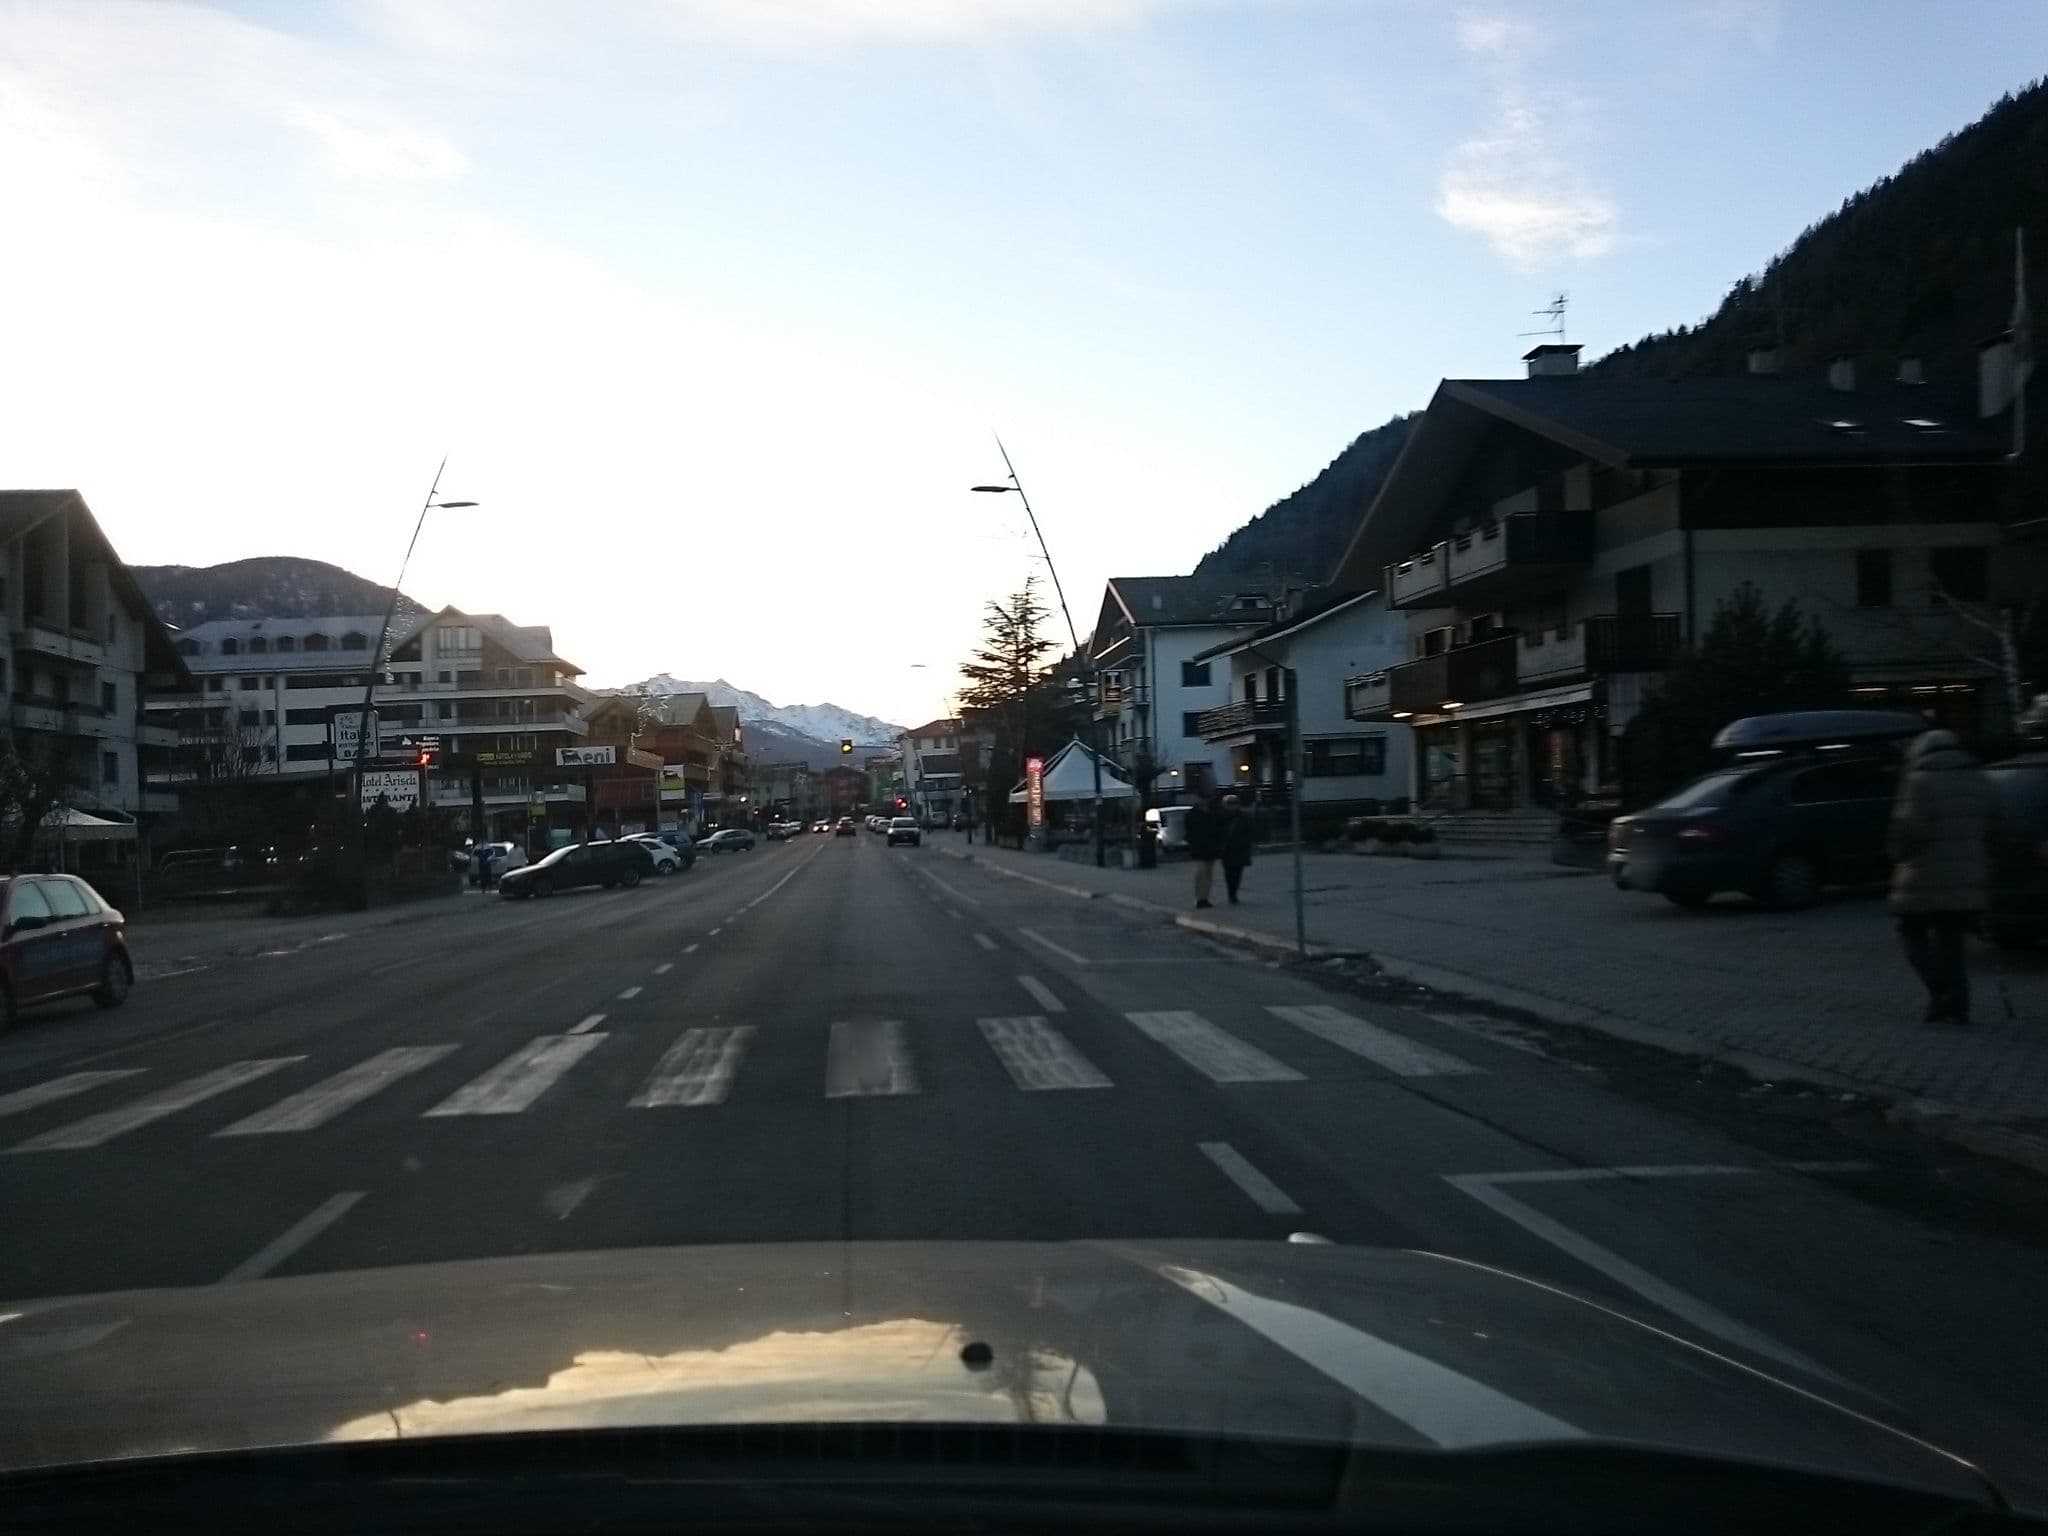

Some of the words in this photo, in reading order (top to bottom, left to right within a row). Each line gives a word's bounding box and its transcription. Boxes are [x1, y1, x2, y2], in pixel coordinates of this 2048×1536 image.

[341, 730, 371, 740] Itala
[583, 747, 610, 764] eni
[362, 793, 418, 803] ISTANTE
